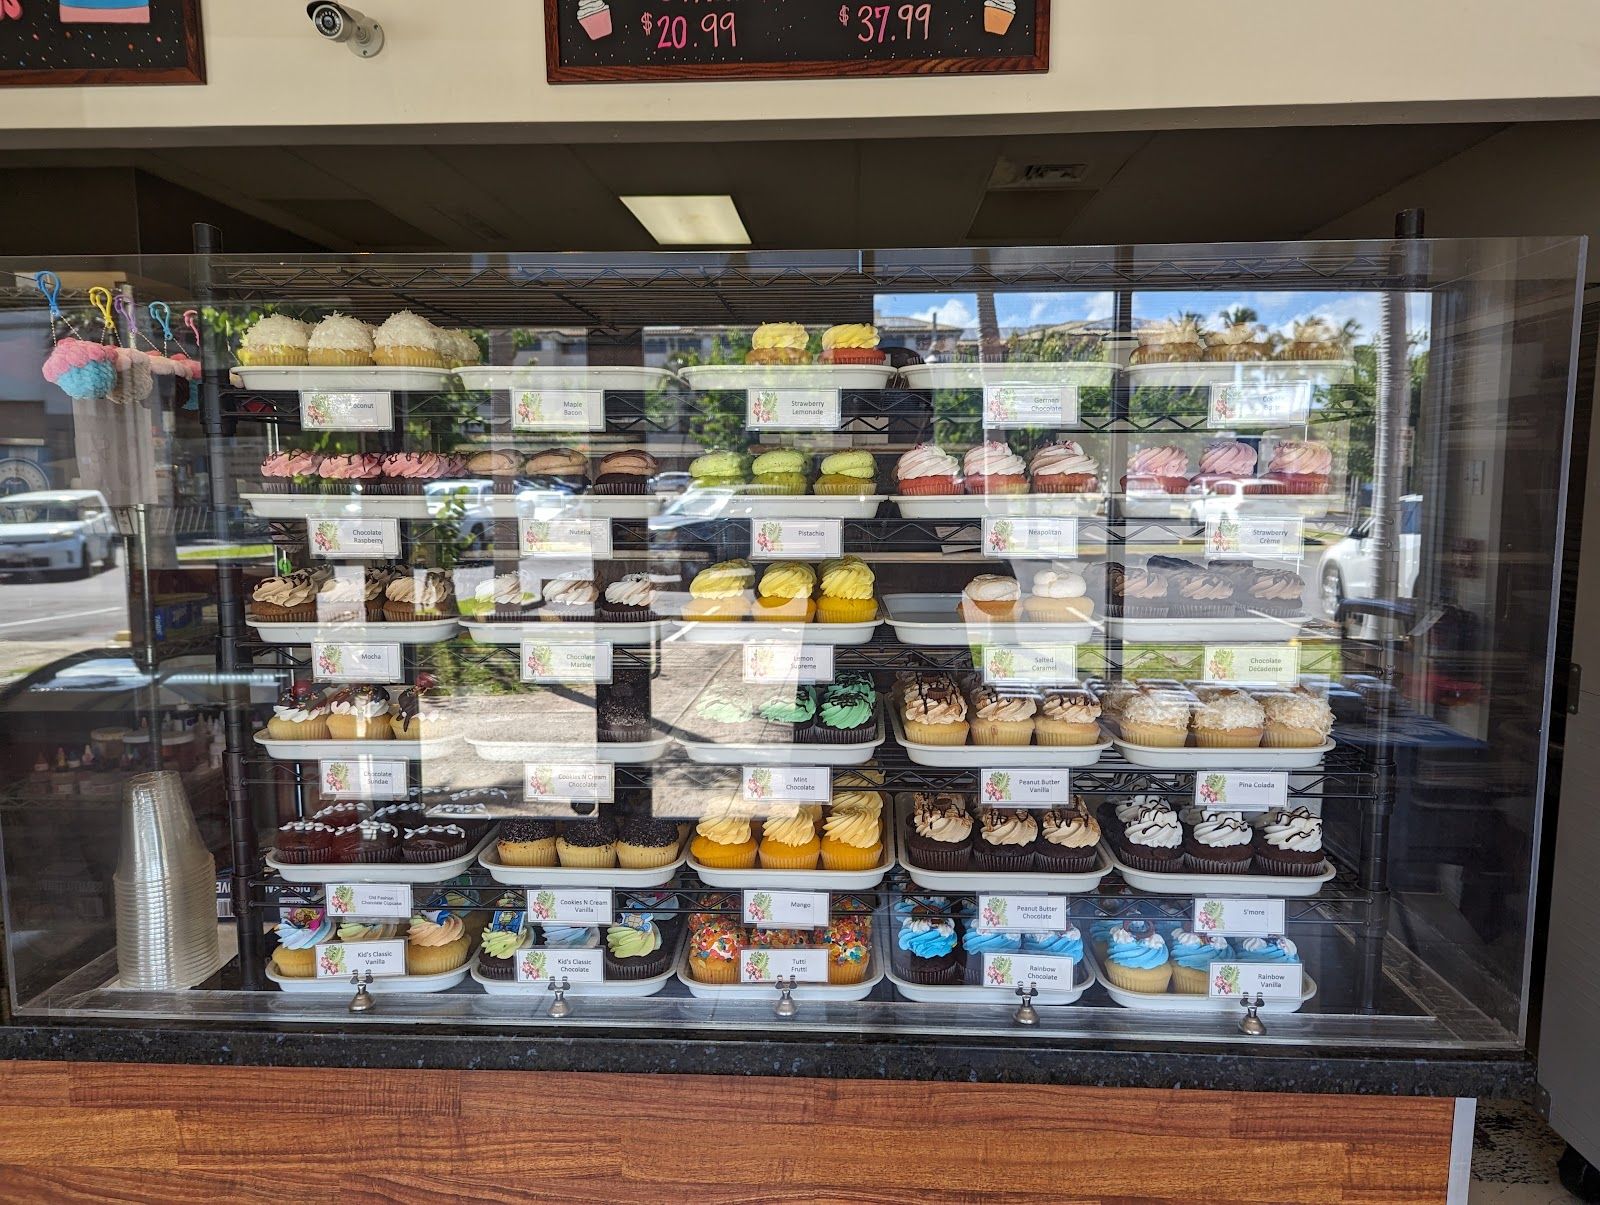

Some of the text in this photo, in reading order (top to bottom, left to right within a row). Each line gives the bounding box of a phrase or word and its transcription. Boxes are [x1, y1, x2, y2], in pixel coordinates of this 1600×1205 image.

[838, 4, 931, 43] $37.99
[641, 12, 736, 48] $20.99
[563, 401, 582, 409] Maple
[791, 400, 825, 408] Strawberry
[1028, 529, 1062, 537] Neapolitan
[1252, 529, 1288, 537] Strawberry
[1029, 965, 1057, 973] Rainbow
